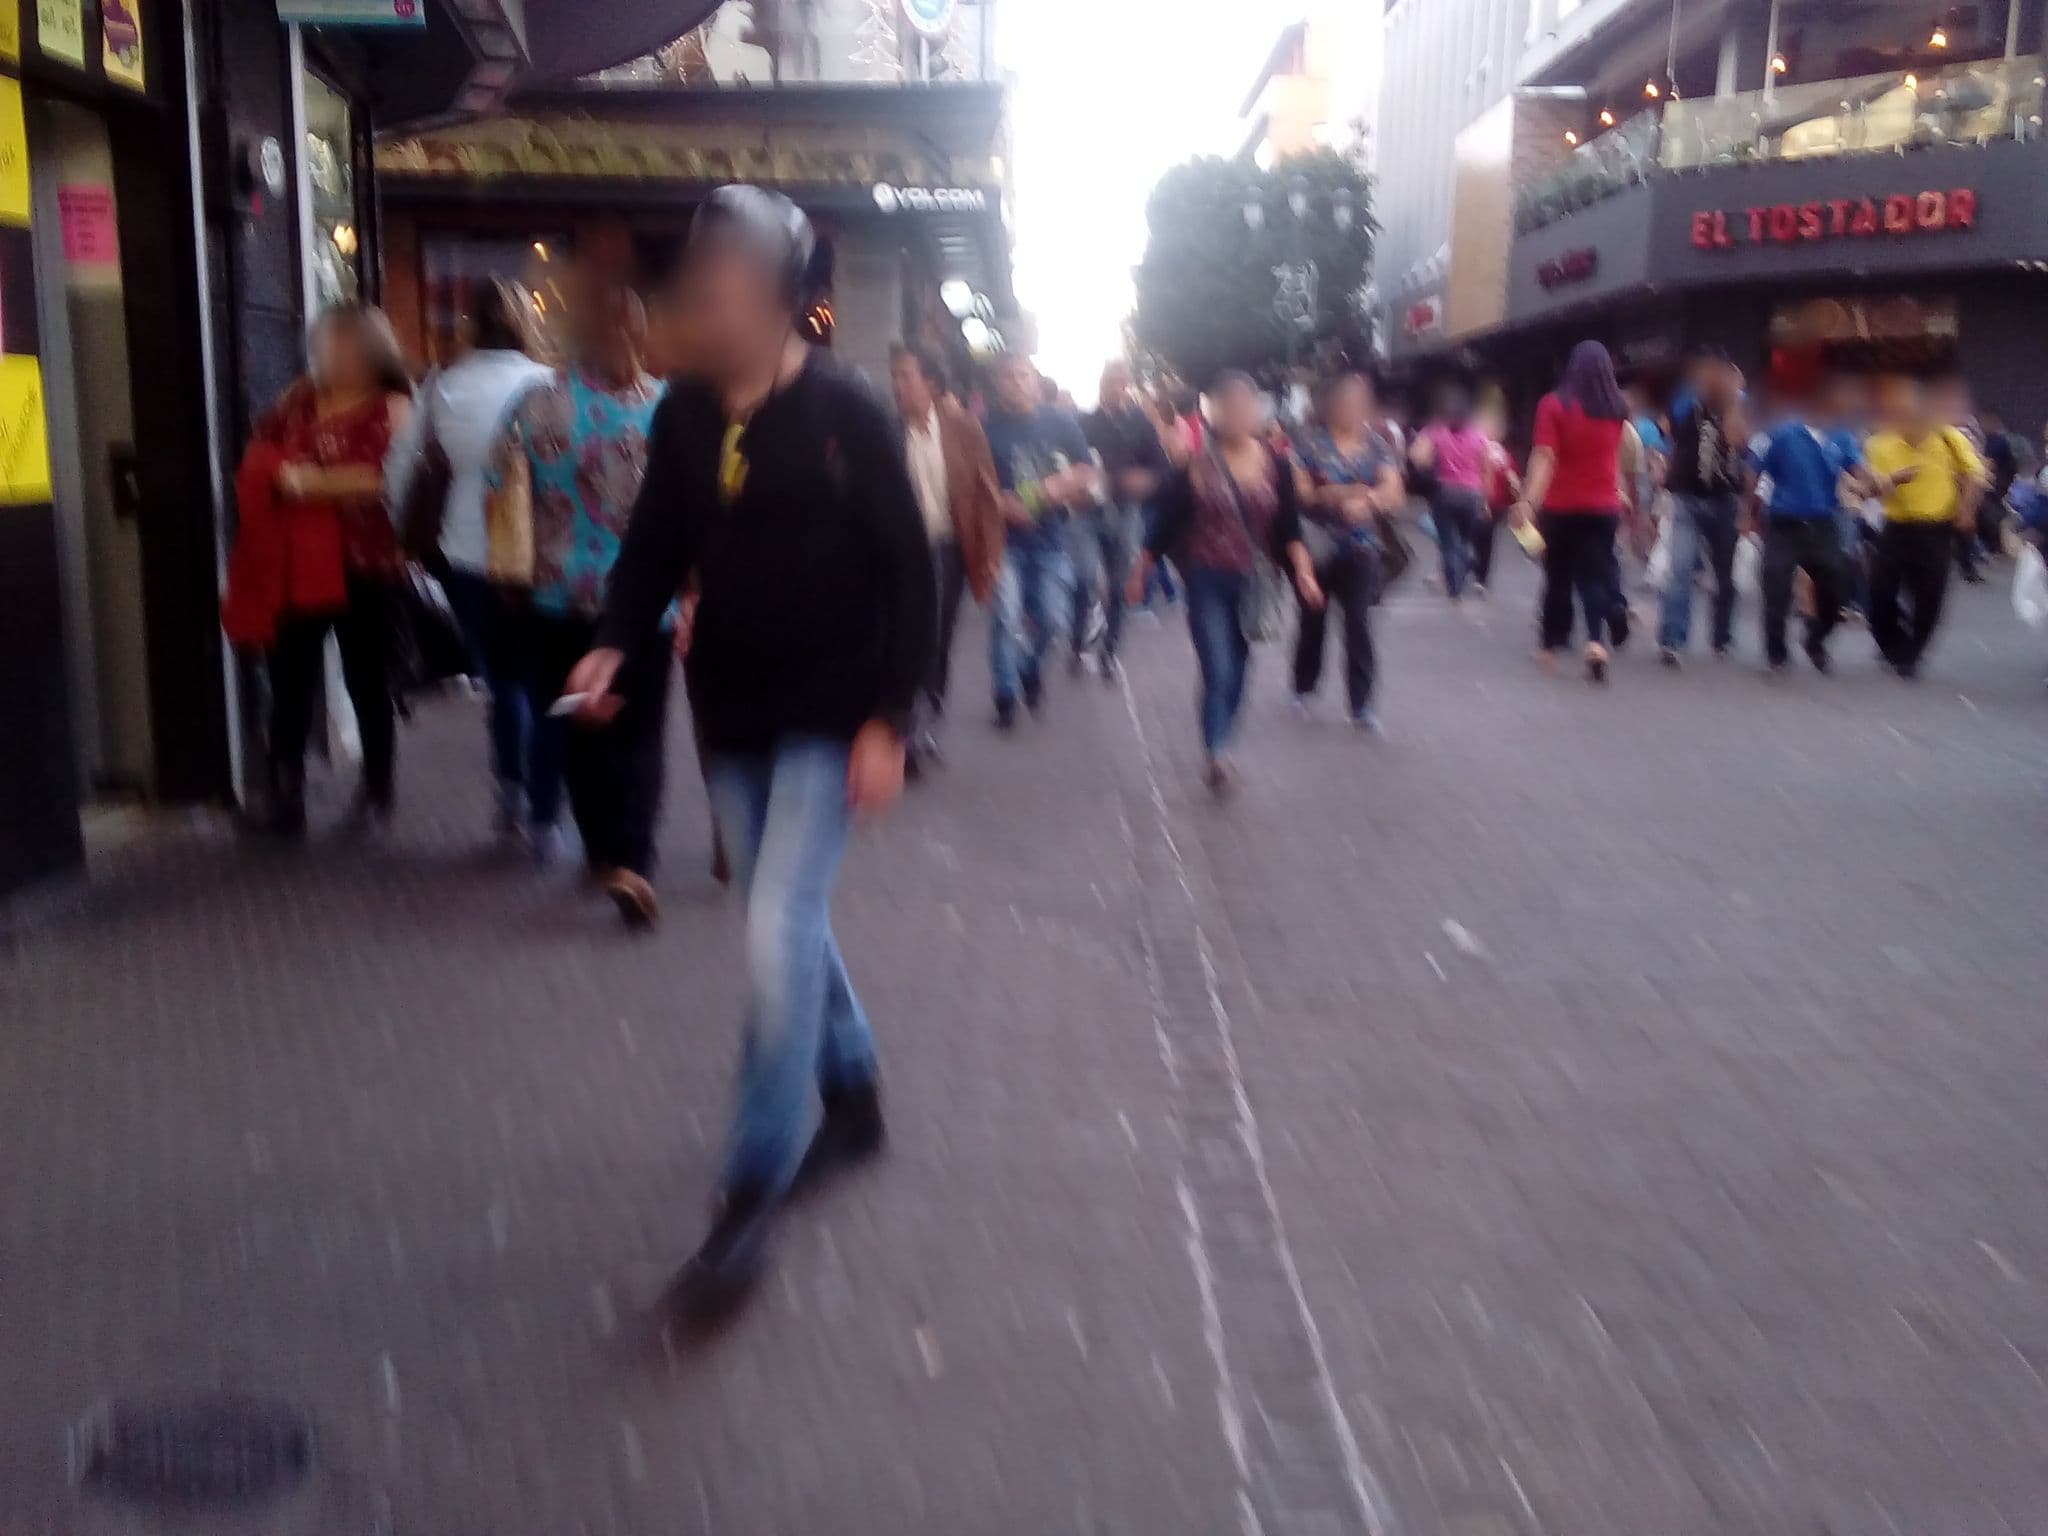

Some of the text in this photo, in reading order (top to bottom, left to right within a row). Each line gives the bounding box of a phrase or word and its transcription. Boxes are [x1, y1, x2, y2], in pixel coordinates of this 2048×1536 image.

[894, 186, 986, 212] VOLCOM
[1691, 188, 1977, 248] EL TOSTADOR
